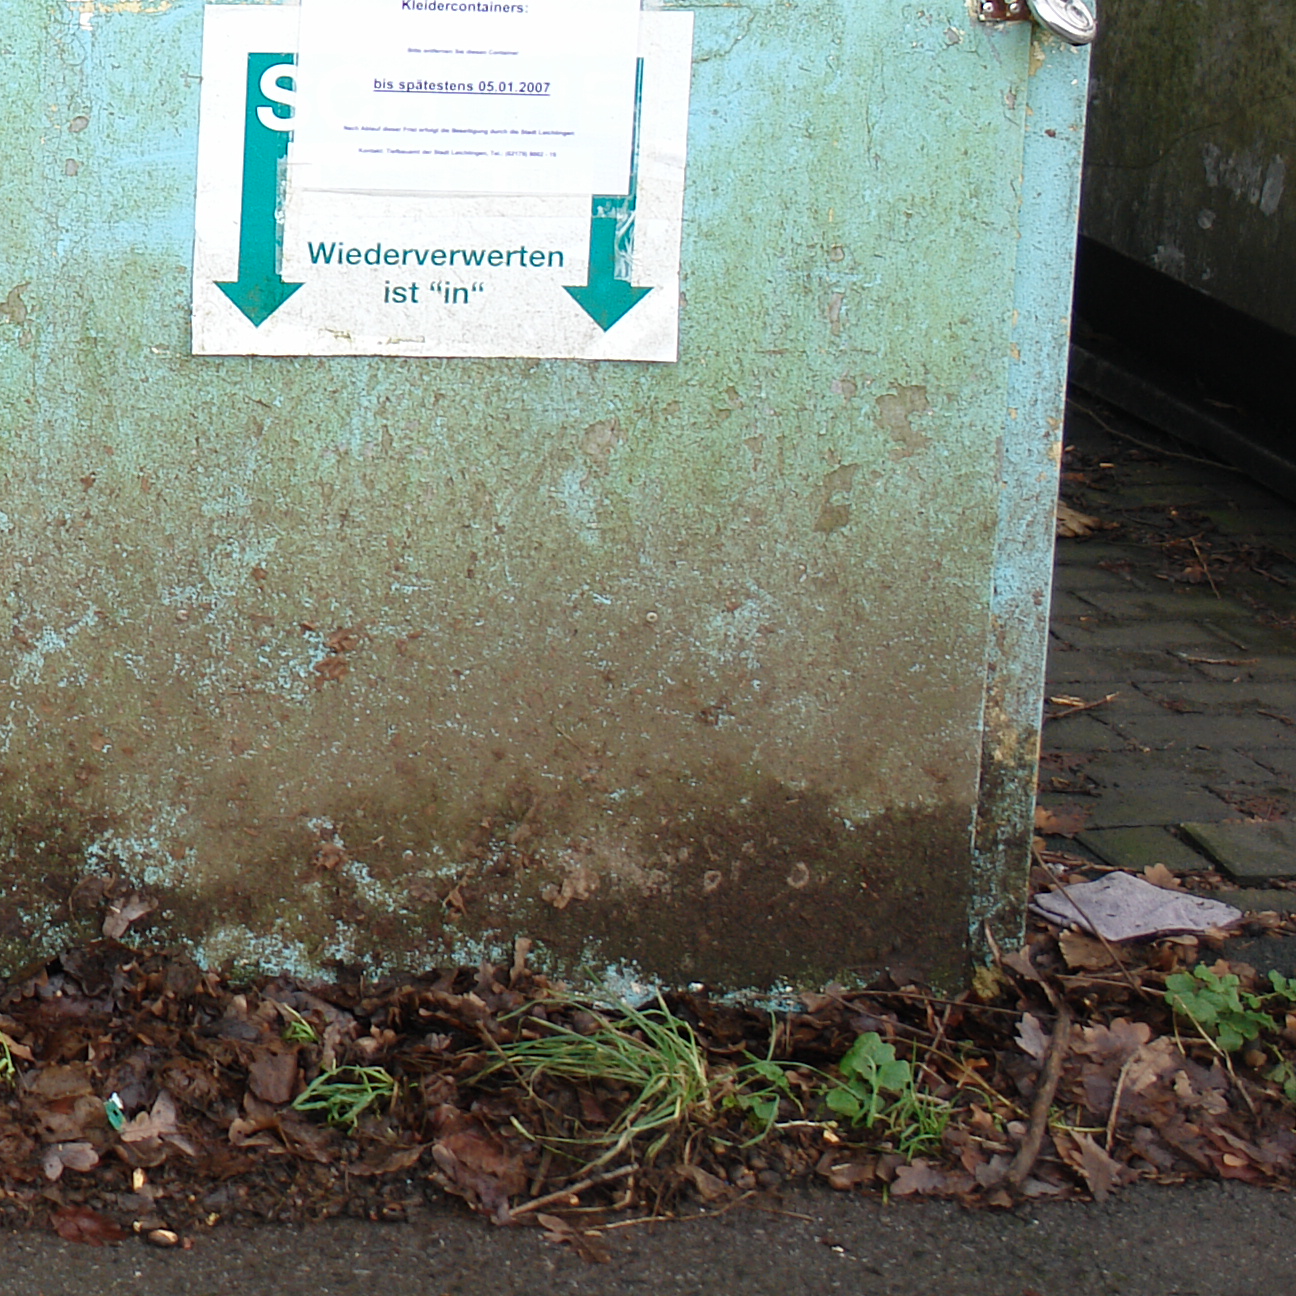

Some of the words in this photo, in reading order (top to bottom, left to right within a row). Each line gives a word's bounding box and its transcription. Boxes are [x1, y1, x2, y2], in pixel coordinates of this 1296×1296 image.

[372, 78, 395, 91] bis
[397, 79, 475, 94] spätestens
[477, 80, 551, 94] 05.01.2007
[307, 241, 565, 268] Wiederverwerten
[383, 280, 420, 305] ist
